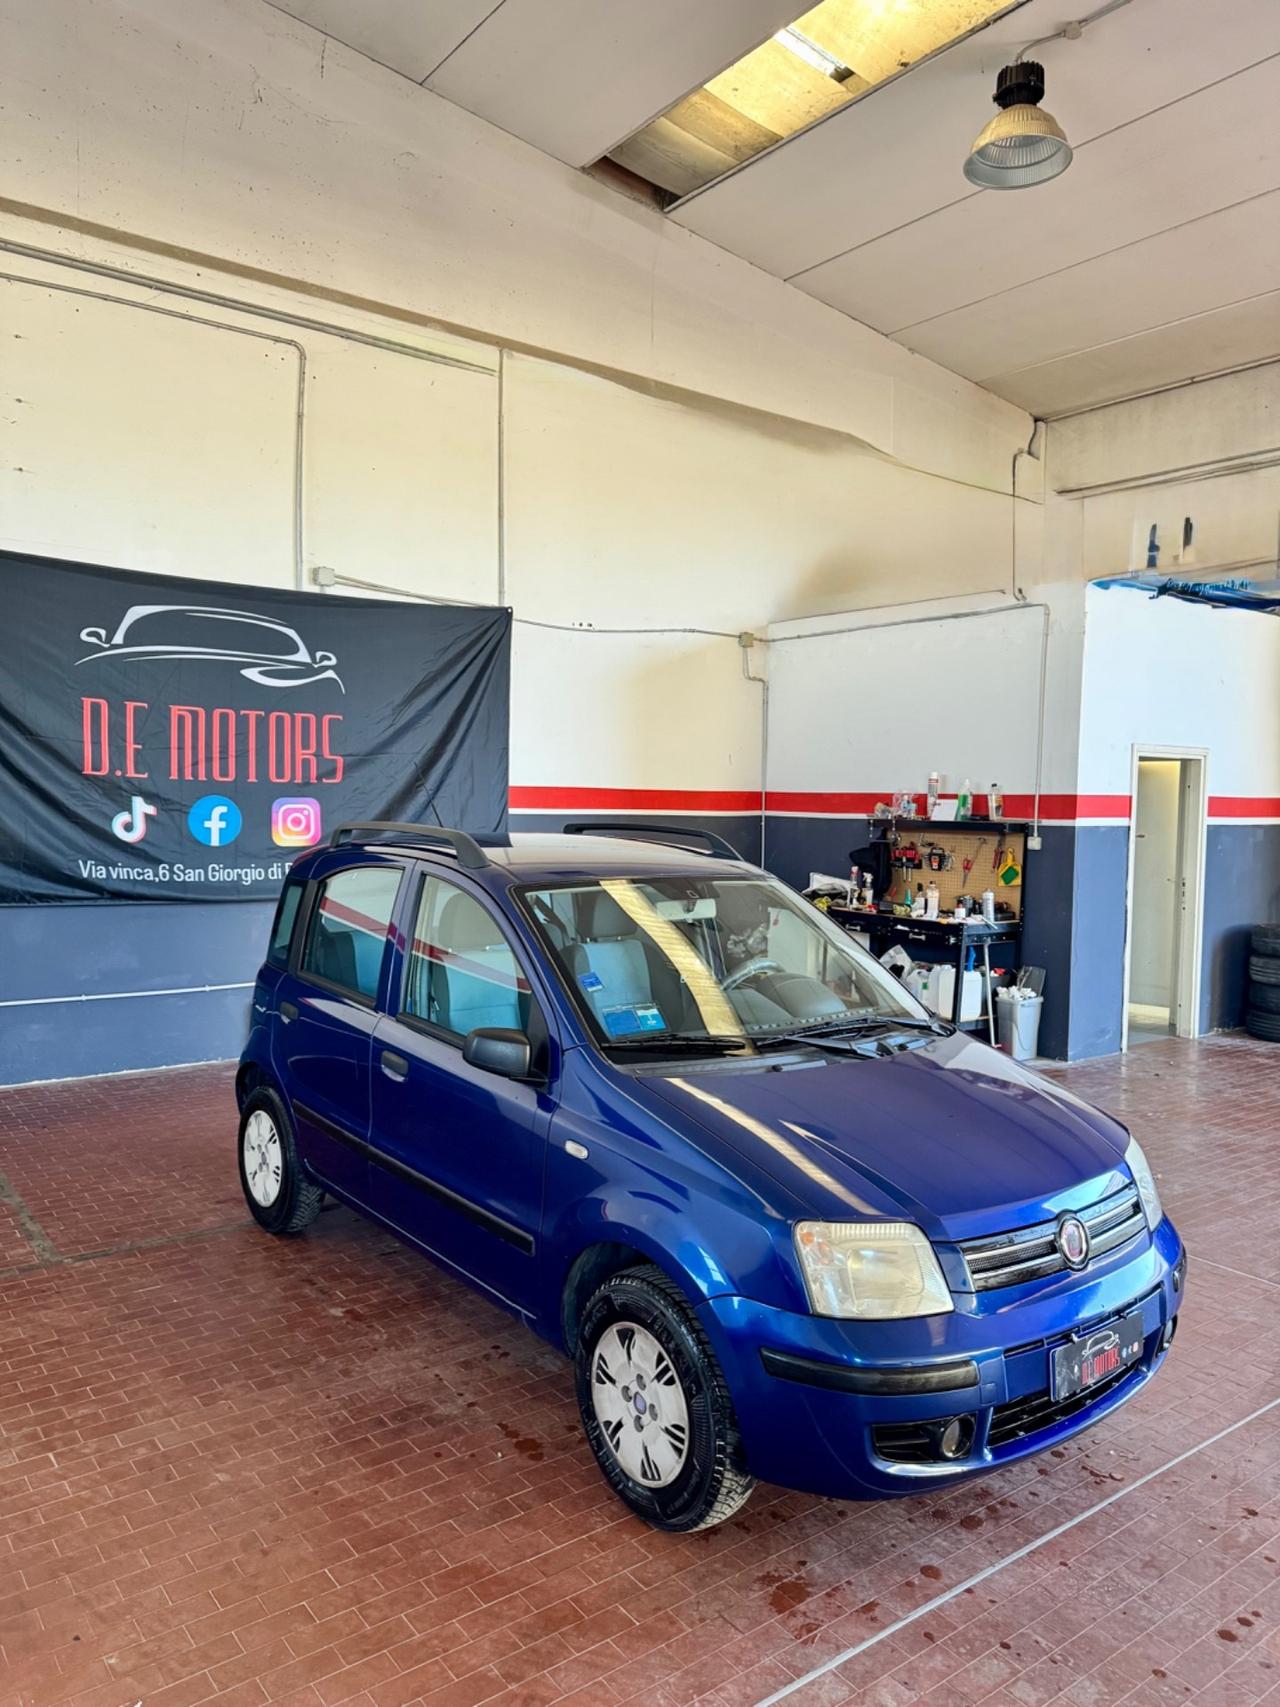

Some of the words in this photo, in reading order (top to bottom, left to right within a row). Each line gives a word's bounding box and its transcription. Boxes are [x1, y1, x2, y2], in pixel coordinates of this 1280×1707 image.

[81, 697, 148, 778] D.E
[169, 705, 344, 784] MOTORS
[79, 859, 106, 880] Via
[109, 862, 169, 883] vinca,6
[173, 864, 204, 881] San
[208, 863, 264, 885] Giorgio
[268, 862, 282, 879] di
